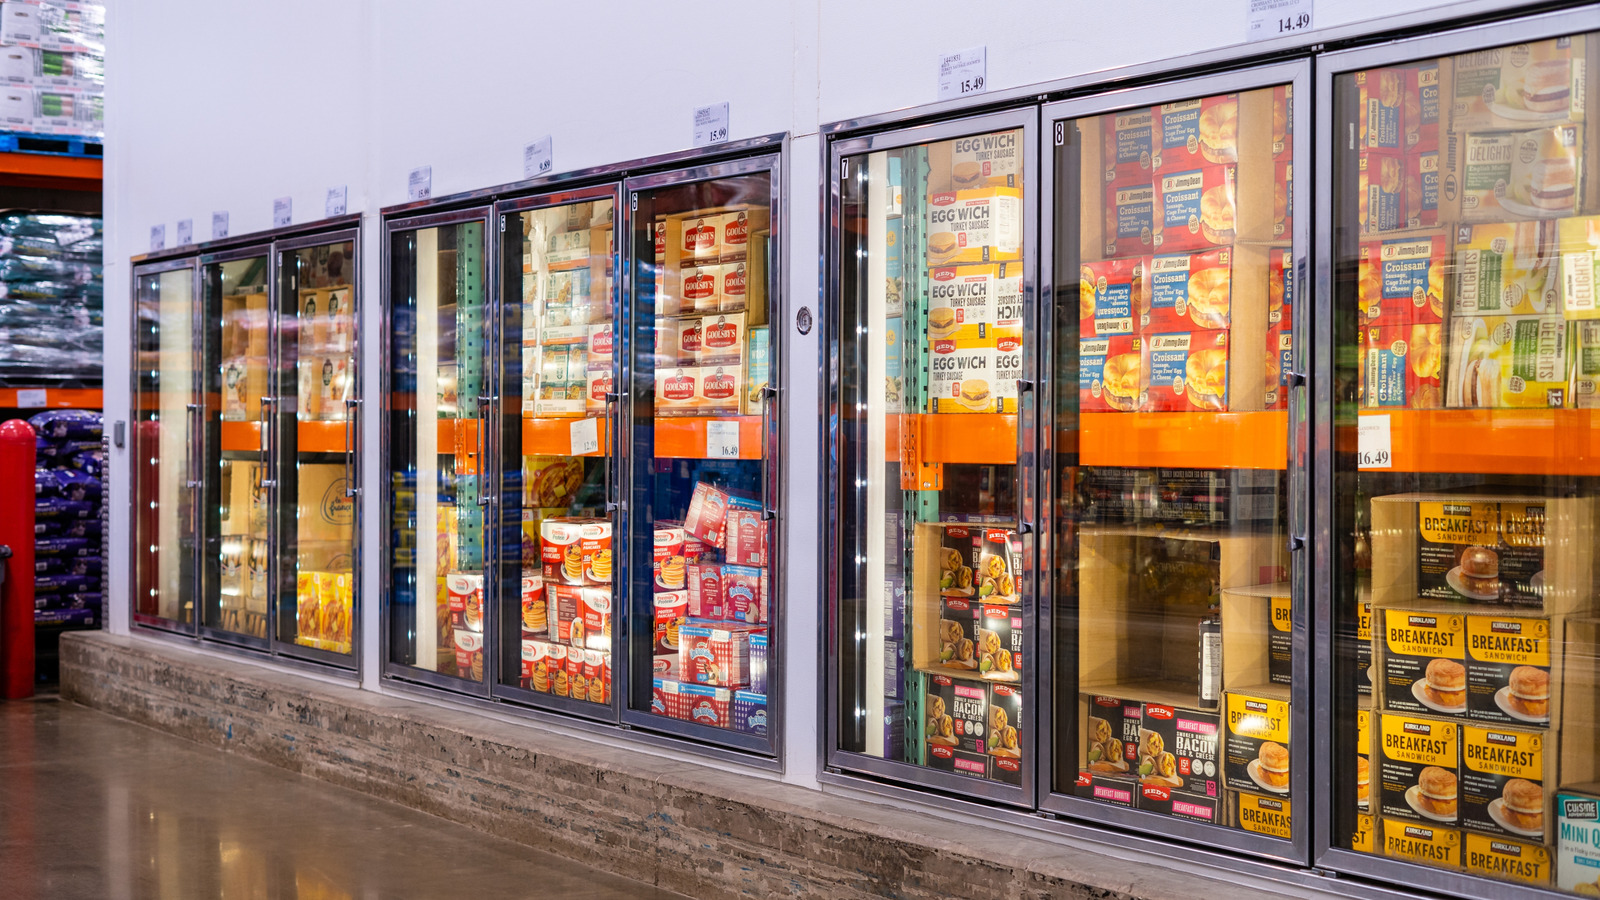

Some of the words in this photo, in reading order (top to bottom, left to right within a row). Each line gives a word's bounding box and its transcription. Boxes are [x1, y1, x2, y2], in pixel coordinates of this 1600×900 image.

[1278, 14, 1310, 32] 14.49
[961, 77, 984, 93] 15.49
[1165, 111, 1197, 124] Croissant
[710, 128, 726, 141] 15.99
[1056, 123, 1063, 143] 8
[1119, 129, 1150, 140] Croissant
[976, 151, 993, 161] TURKEY
[994, 148, 1014, 158] SAUSAGE
[1447, 136, 1457, 172] Jimmy
[1470, 145, 1512, 161] DELIGHTS
[842, 160, 847, 176] 7
[1360, 159, 1367, 167] 12
[1166, 192, 1199, 203] Croissant
[1120, 205, 1150, 215] Croissant
[951, 221, 967, 231] TURKEY
[969, 220, 989, 230] SAUSAGE
[687, 231, 714, 242] GOOLSBY'S
[1459, 228, 1468, 242] 12
[1398, 247, 1415, 255] Jimmy
[1416, 245, 1428, 253] Dean
[1385, 261, 1426, 272] Croissant
[1154, 273, 1186, 283] Croissant
[1463, 252, 1477, 308] DELIGHTS
[1575, 252, 1591, 306] DELIGHTS
[686, 281, 714, 290] GOOLSBY'S
[951, 298, 966, 307] TURKEY
[967, 297, 986, 306] SAUSAGE
[1098, 307, 1128, 317] Croissant
[707, 329, 736, 339] GOOLSBY'S
[751, 350, 764, 360] WRAP
[1540, 322, 1555, 380] DELIGHTS
[1153, 352, 1184, 362] Croissant
[933, 372, 946, 380] TURKEY
[947, 371, 963, 380] SAUSAGE
[665, 383, 694, 391] GOOLSBY'S
[705, 380, 734, 389] GOOLSBY'S
[1552, 391, 1561, 405] 12
[722, 446, 738, 455] 16.49
[1358, 451, 1388, 465] 16.49
[1425, 518, 1488, 534] BREAKFAST
[1409, 616, 1436, 624] KIRKLAND
[1492, 622, 1521, 631] KIRKLAND
[1391, 629, 1454, 647] BREAKFAST
[1402, 644, 1443, 654] SANDWICH
[1472, 635, 1540, 653] BREAKFAST
[1484, 652, 1527, 662] SANDWICH
[954, 701, 983, 716] BACON
[1148, 707, 1171, 717] RED'S
[1178, 720, 1198, 731] BREAKFAST
[1404, 723, 1430, 732] KIRKLAND
[1488, 733, 1516, 742] KIRKLAND
[1176, 737, 1215, 754] BACON
[1386, 734, 1447, 755] BREAKFAST
[1195, 752, 1215, 760] CHEESE
[1397, 751, 1436, 762] SANDWICH
[1468, 744, 1534, 767] BREAKFAST
[999, 760, 1017, 768] RED'S
[1479, 762, 1522, 774] SANDWICH
[1095, 788, 1113, 797] BREAKFAST
[1114, 790, 1129, 800] BURRITO
[1144, 789, 1168, 798] RED'S
[1174, 802, 1193, 813] BREAKFAST
[1195, 806, 1210, 816] BURRITO
[1259, 799, 1282, 808] KIRKLAND
[1253, 824, 1288, 836] SANDWICH
[1405, 827, 1432, 837] KIRKLAND
[1389, 837, 1450, 861] BREAKFAST
[1492, 842, 1521, 853] KIRKLAND
[1575, 848, 1588, 856] flaky
[1471, 852, 1540, 878] BREAKFAST
